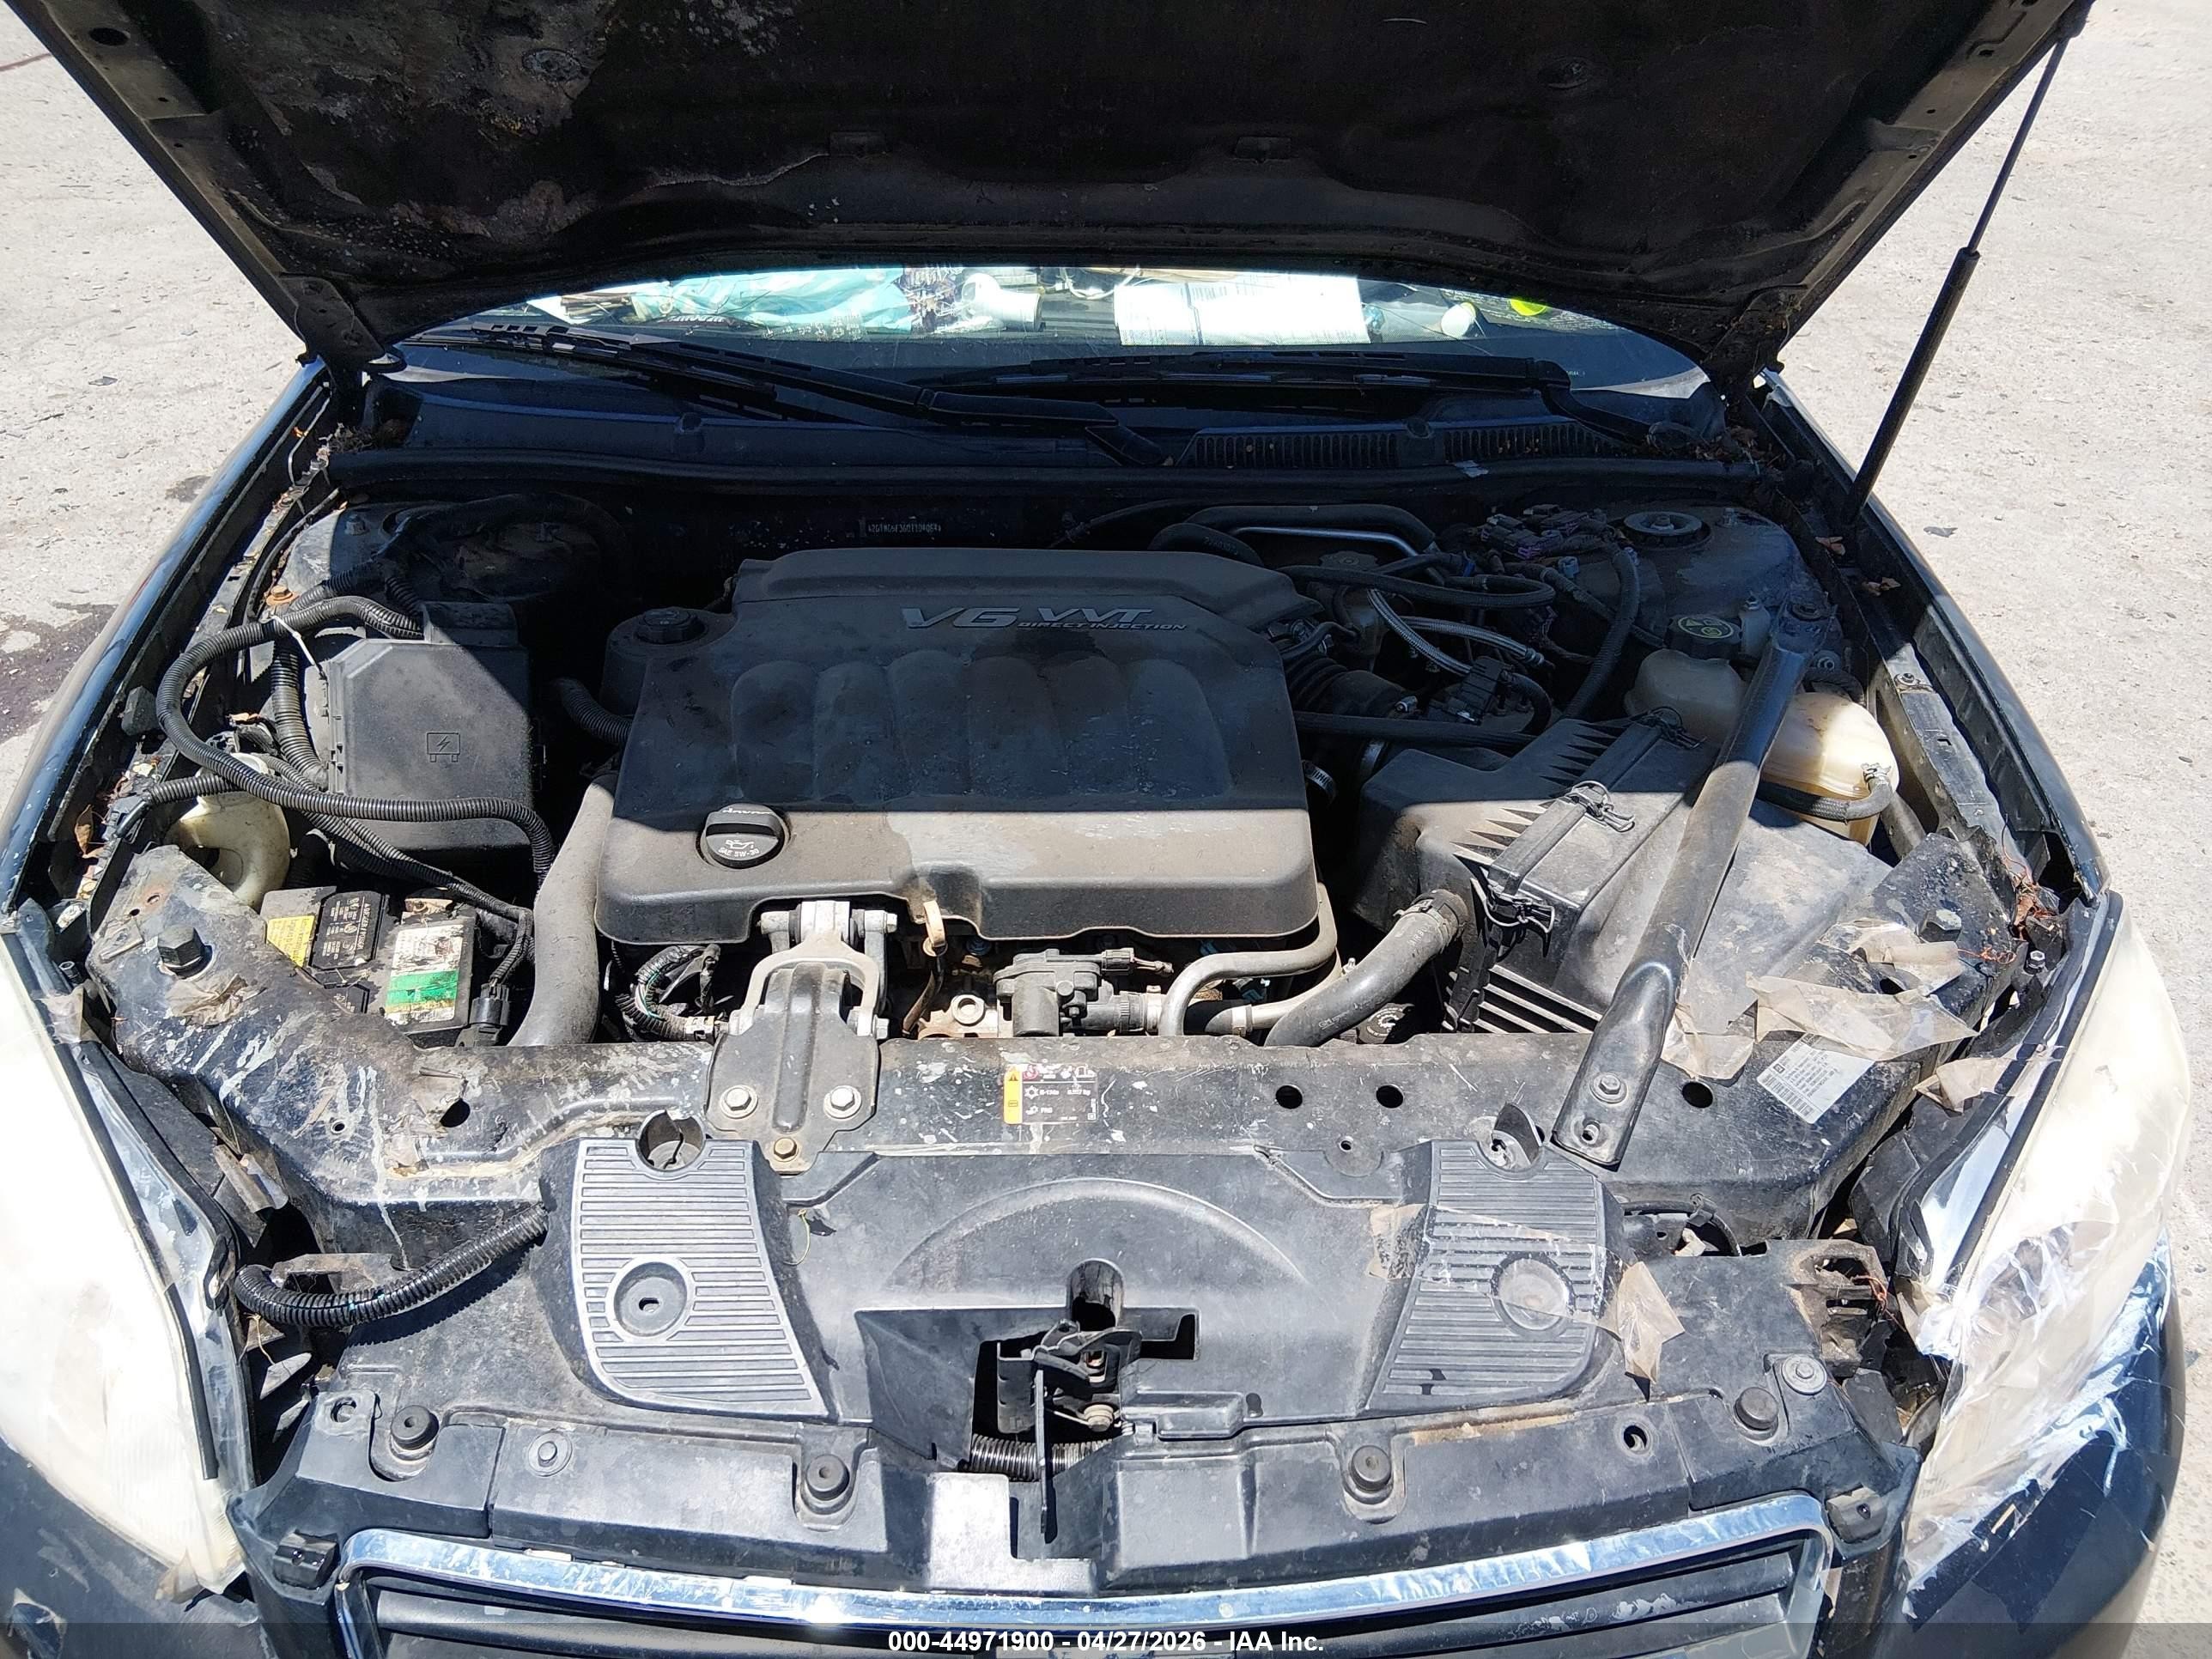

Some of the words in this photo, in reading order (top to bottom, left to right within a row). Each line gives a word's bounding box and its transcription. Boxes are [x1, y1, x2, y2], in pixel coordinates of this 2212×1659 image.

[902, 607, 1021, 629] V6
[1036, 607, 1153, 623] VVT
[718, 847, 733, 856] SAE
[734, 848, 760, 857] 5W-30
